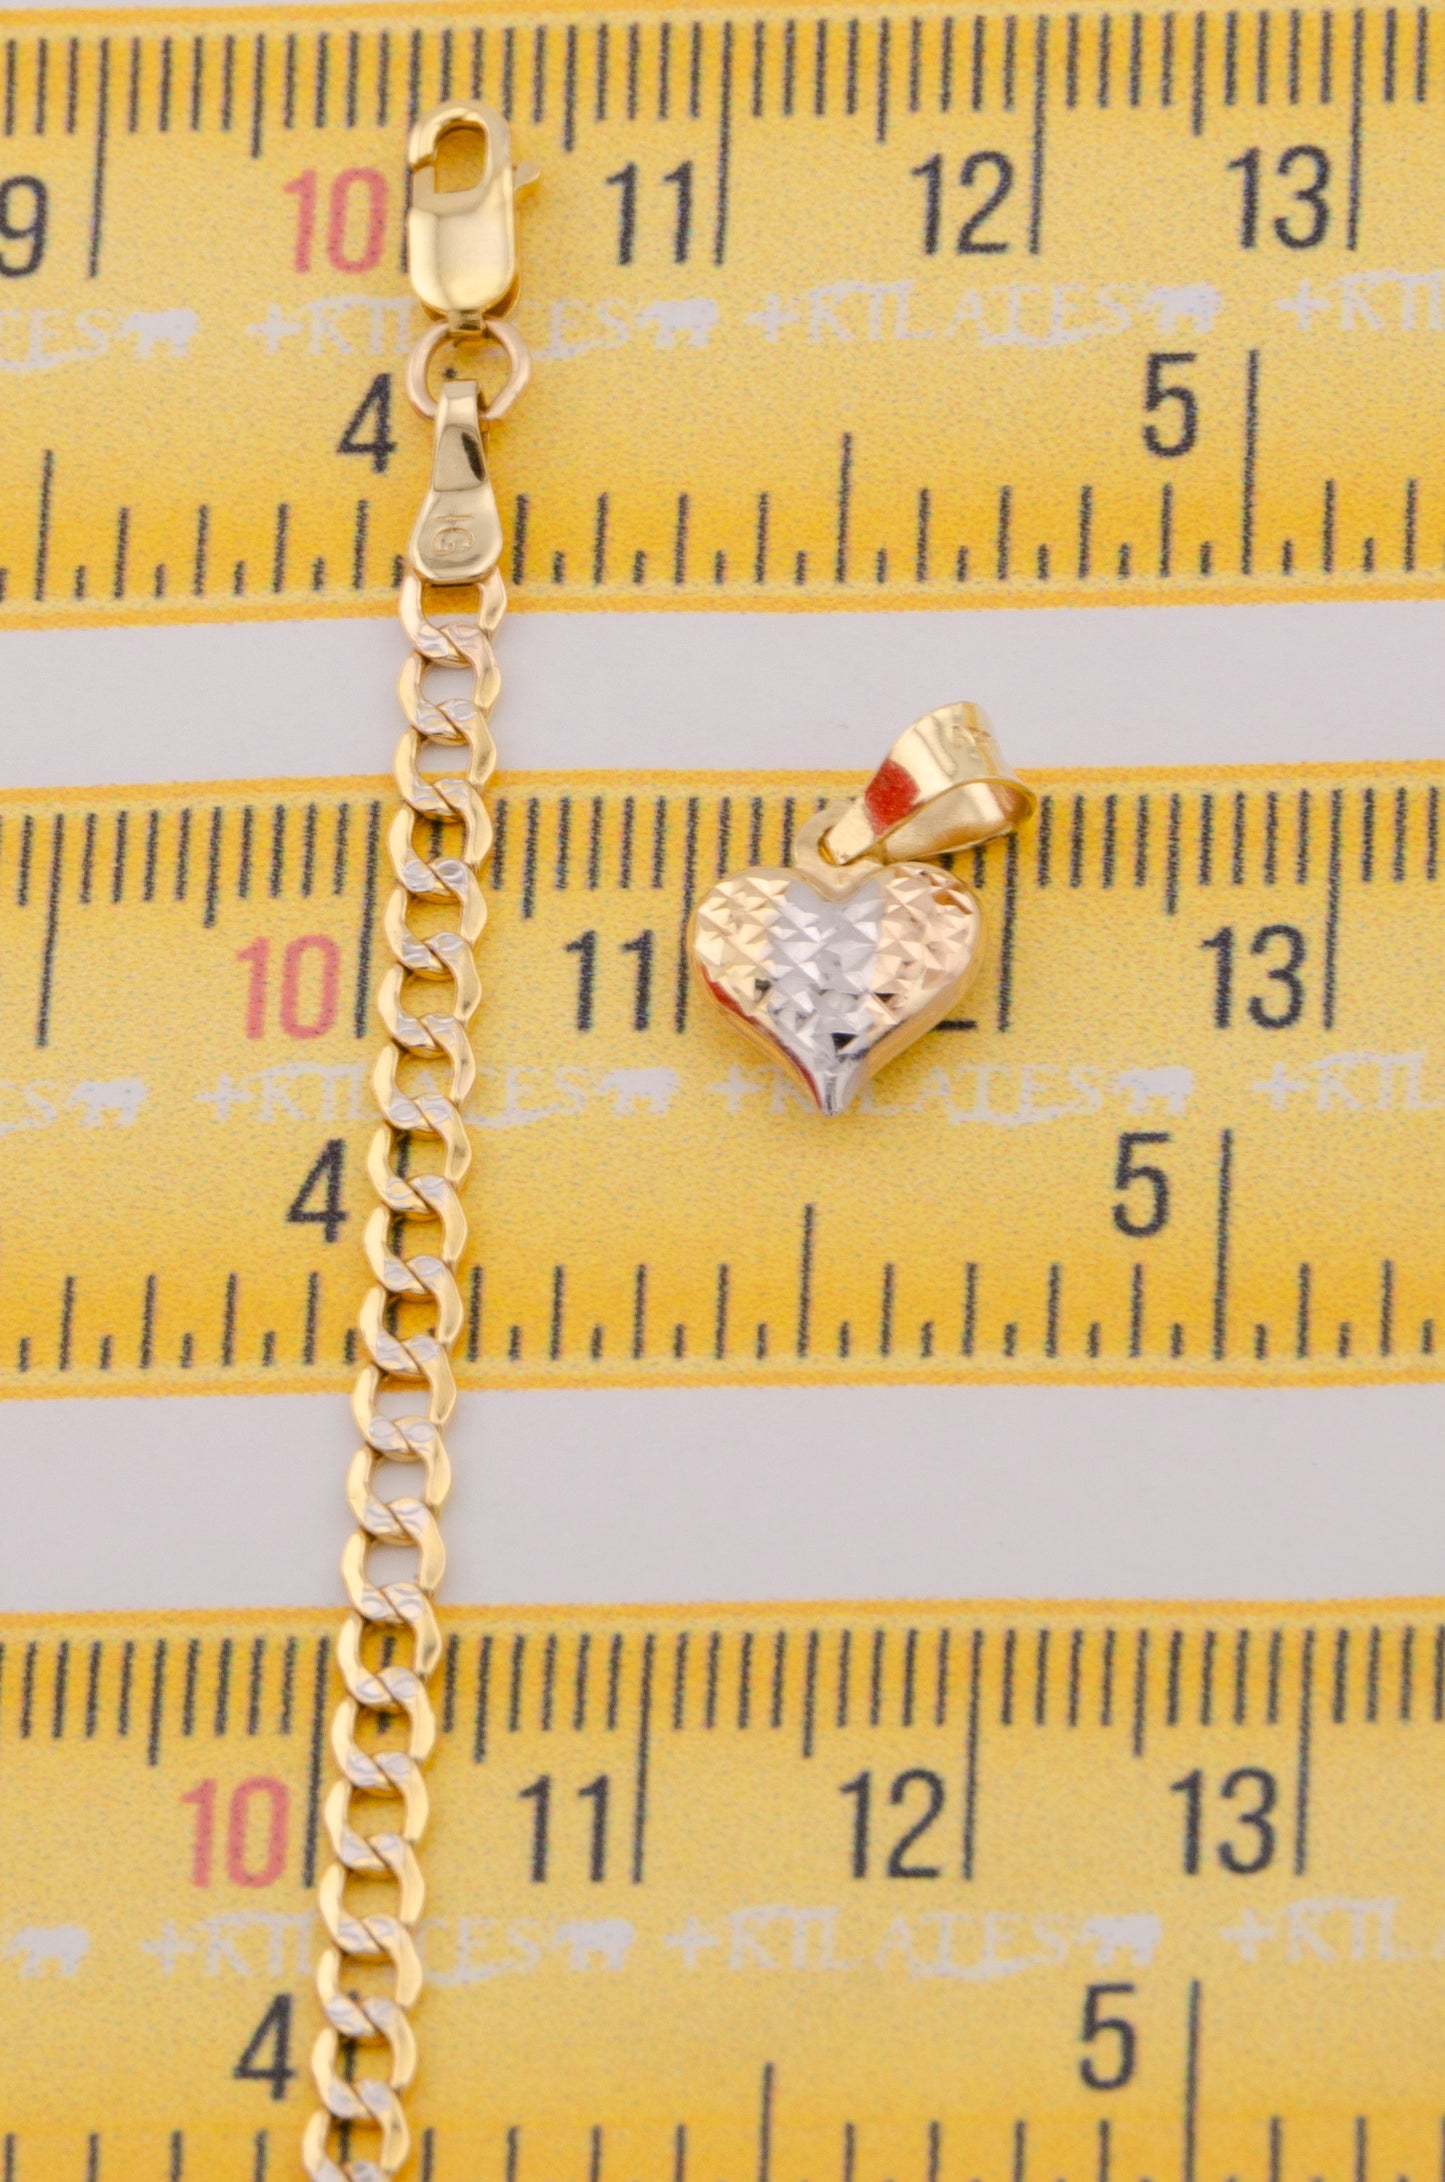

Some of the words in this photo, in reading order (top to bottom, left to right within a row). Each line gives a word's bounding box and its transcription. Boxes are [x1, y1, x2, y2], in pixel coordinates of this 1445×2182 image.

[0, 176, 47, 278] 9
[283, 167, 390, 275] 10
[608, 163, 691, 265] 11
[913, 152, 1012, 254] 12
[1229, 146, 1330, 249] 13
[338, 374, 396, 473] 4
[1144, 353, 1197, 457] 5
[236, 933, 342, 1040] 10
[566, 931, 652, 1031] 11
[1203, 925, 1305, 1029] 13
[287, 1140, 347, 1243] 4
[1114, 1133, 1169, 1237] 5
[180, 1774, 291, 1888] 10
[521, 1776, 608, 1882] 11
[842, 1768, 945, 1879] 12
[1172, 1768, 1276, 1875] 13
[234, 1994, 295, 2100] 4
[1080, 1983, 1135, 2090] 5
